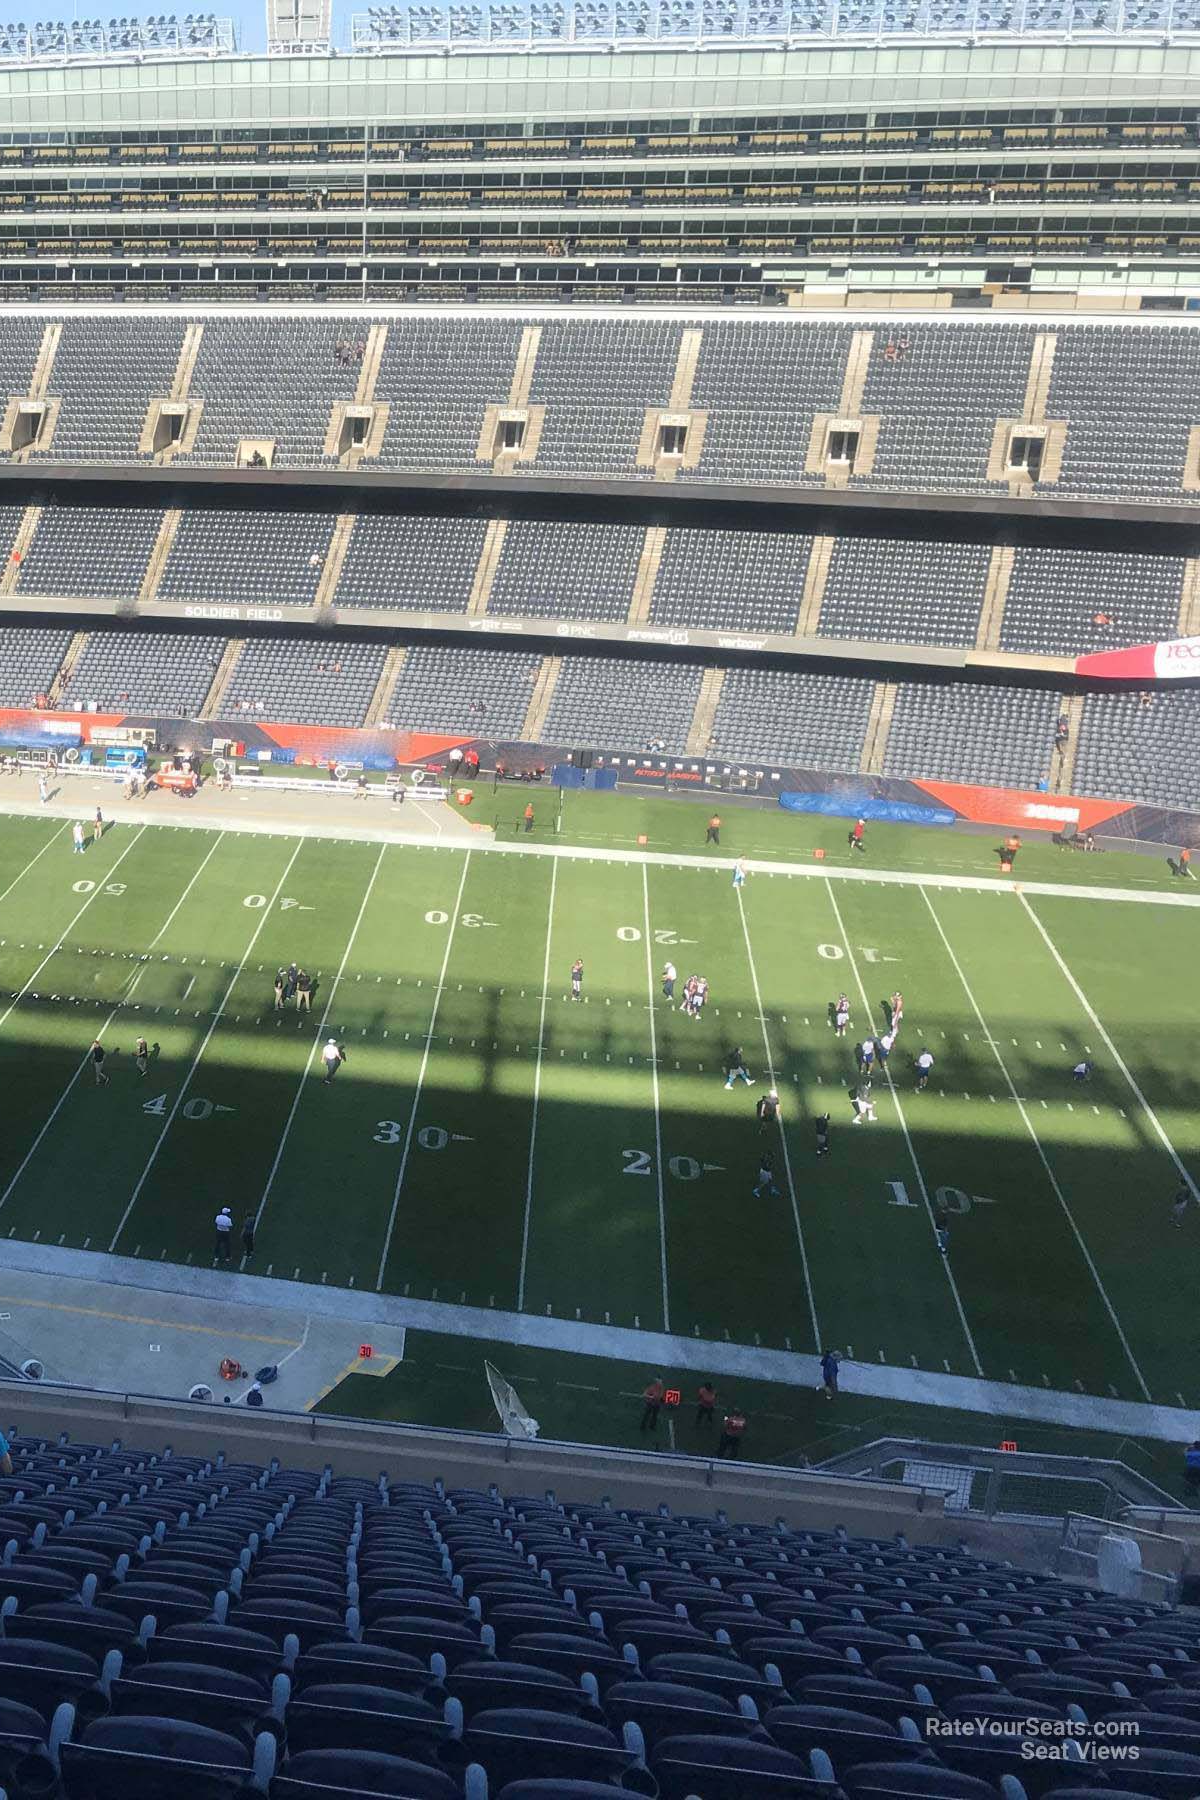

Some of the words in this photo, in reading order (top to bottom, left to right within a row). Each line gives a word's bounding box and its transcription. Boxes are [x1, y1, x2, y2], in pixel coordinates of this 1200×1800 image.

[184, 605, 240, 618] SOLDIER
[246, 608, 282, 620] FIELD
[570, 626, 595, 636] PNC
[72, 880, 128, 896] 50
[243, 895, 299, 911] 40
[425, 910, 484, 928] 30
[616, 926, 679, 945] 20
[817, 943, 881, 963] 10
[142, 1094, 214, 1120] 40
[373, 1120, 448, 1150] 30
[622, 1149, 700, 1181] 20
[885, 1181, 973, 1214] 10
[360, 1346, 372, 1358] 30
[666, 1391, 679, 1404] 20
